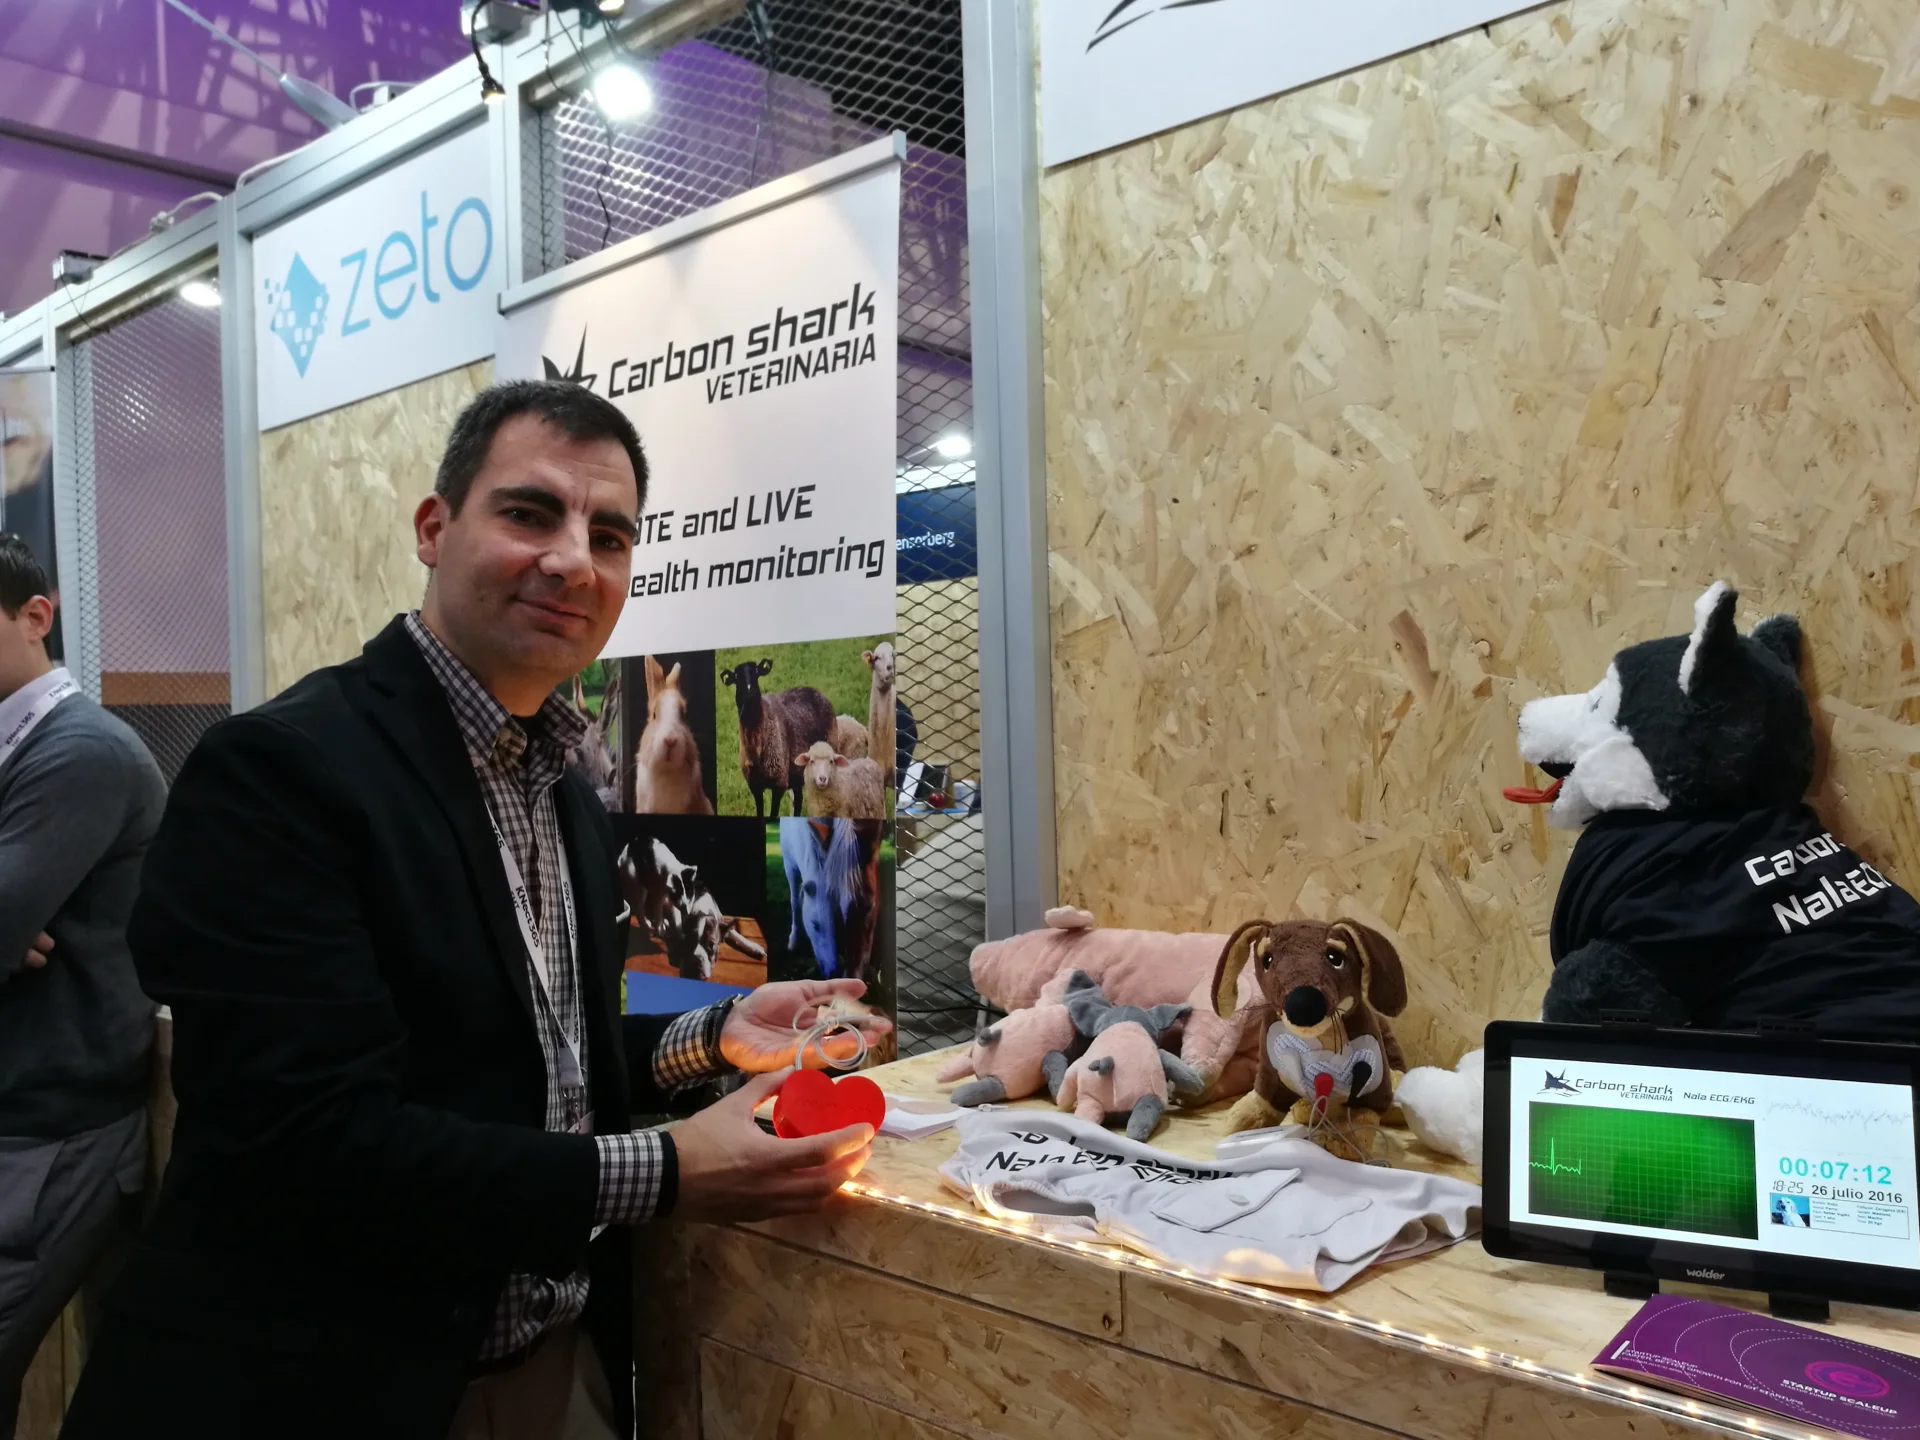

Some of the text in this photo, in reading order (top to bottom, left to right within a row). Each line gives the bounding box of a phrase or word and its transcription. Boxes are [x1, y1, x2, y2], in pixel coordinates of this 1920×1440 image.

[341, 190, 493, 337] zeto
[608, 282, 876, 398] Carbon shark
[706, 333, 876, 404] VETERINARIA
[682, 494, 738, 538] and
[746, 484, 816, 524] LIVE
[627, 536, 886, 598] ealth monitoring
[516, 885, 540, 948] KNect365
[1575, 1078, 1755, 1105] Carbon shark Nala ECG/EKG
[1620, 1091, 1673, 1102] VETERINARIA
[1780, 1157, 1892, 1185] 00:07:12
[1811, 1184, 1828, 1196] 26
[1832, 1187, 1863, 1200] julio
[1868, 1190, 1903, 1203] 2016
[1686, 1268, 1725, 1281] wolder
[1782, 1379, 1837, 1398] STARTUP
[1839, 1396, 1897, 1415] SCALEUP
